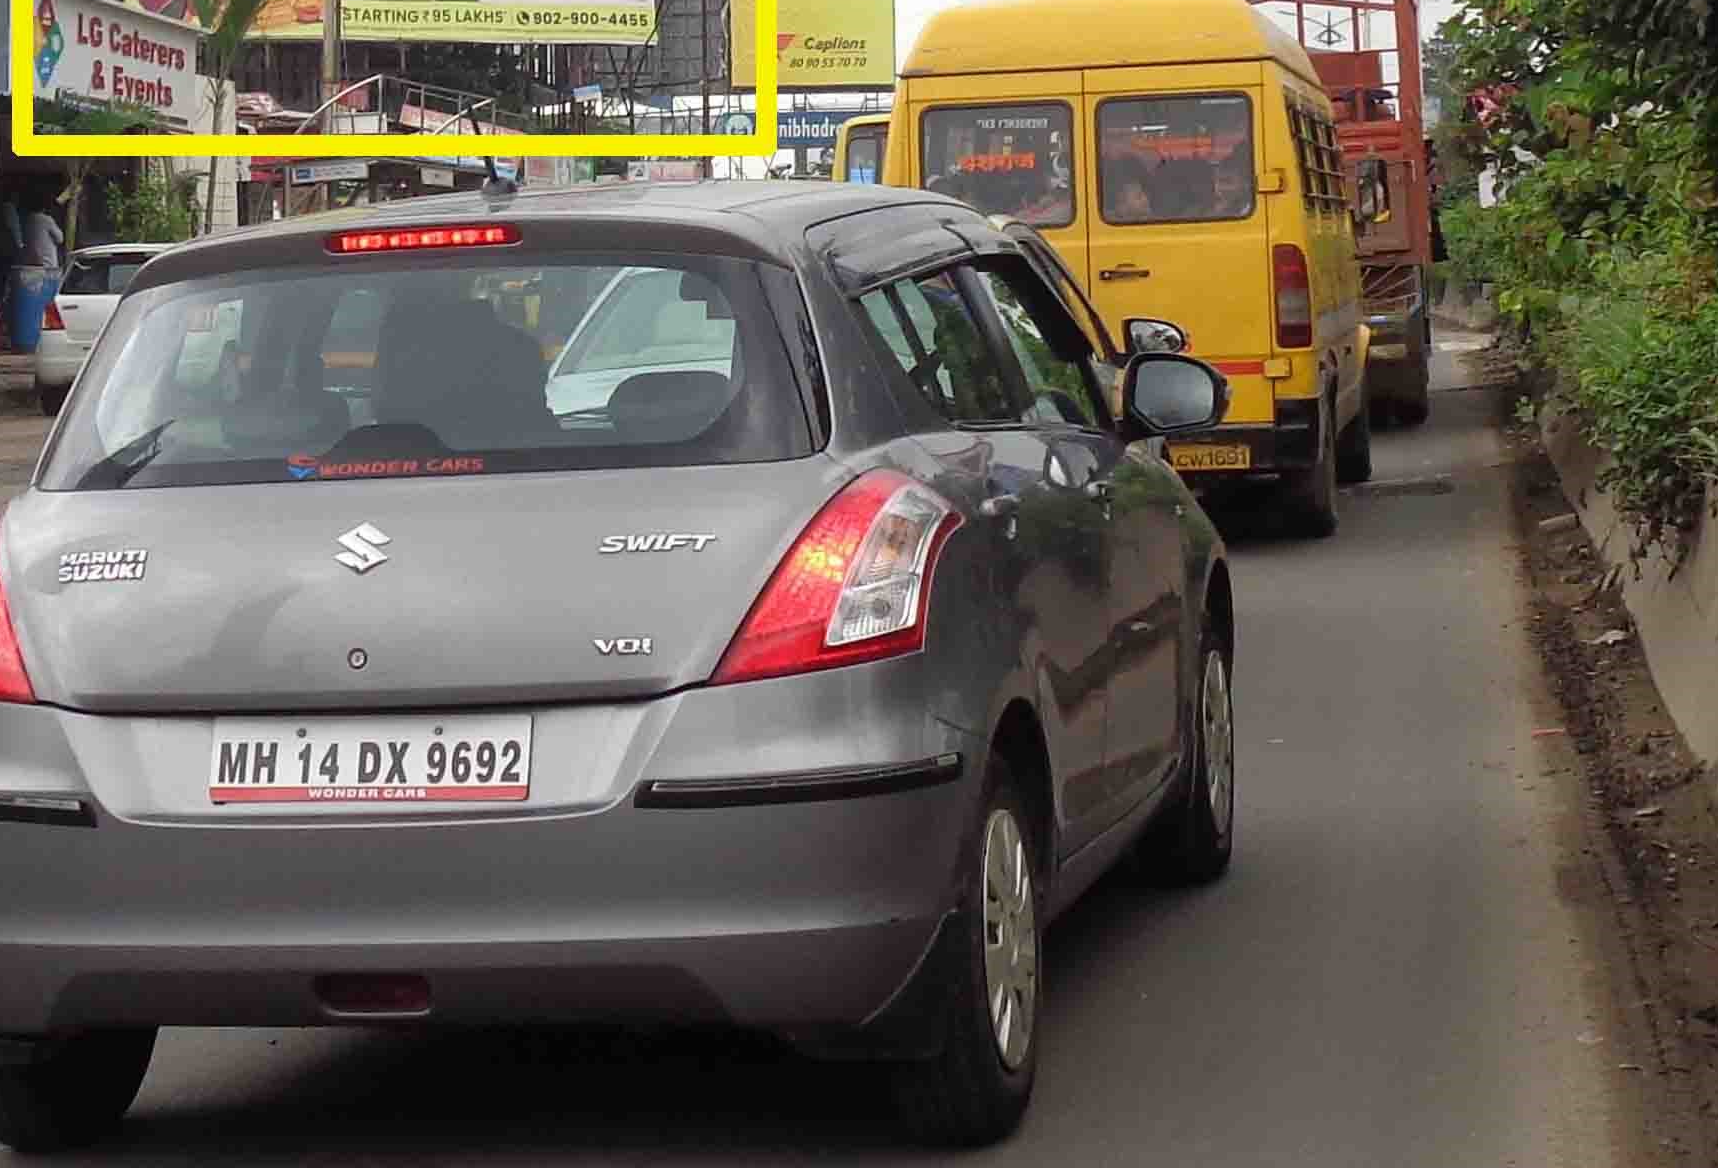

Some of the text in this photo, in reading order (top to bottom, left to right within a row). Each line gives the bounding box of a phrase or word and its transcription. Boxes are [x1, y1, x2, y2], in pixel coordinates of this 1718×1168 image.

[343, 7, 419, 24] STARTING
[533, 11, 649, 27] 902-900-4455
[76, 13, 185, 71] LG Caterers
[91, 59, 105, 90] &
[112, 64, 173, 108] Events
[777, 116, 840, 138] nibhadr
[320, 456, 484, 477] WONDER CARS
[597, 532, 717, 553] SWIFT
[59, 549, 147, 566] MARUTI
[58, 563, 145, 583] SUZUKI
[593, 637, 652, 655] VDI
[218, 739, 522, 784] MH 14 DX 9692
[308, 786, 427, 799] WONDER CARS
